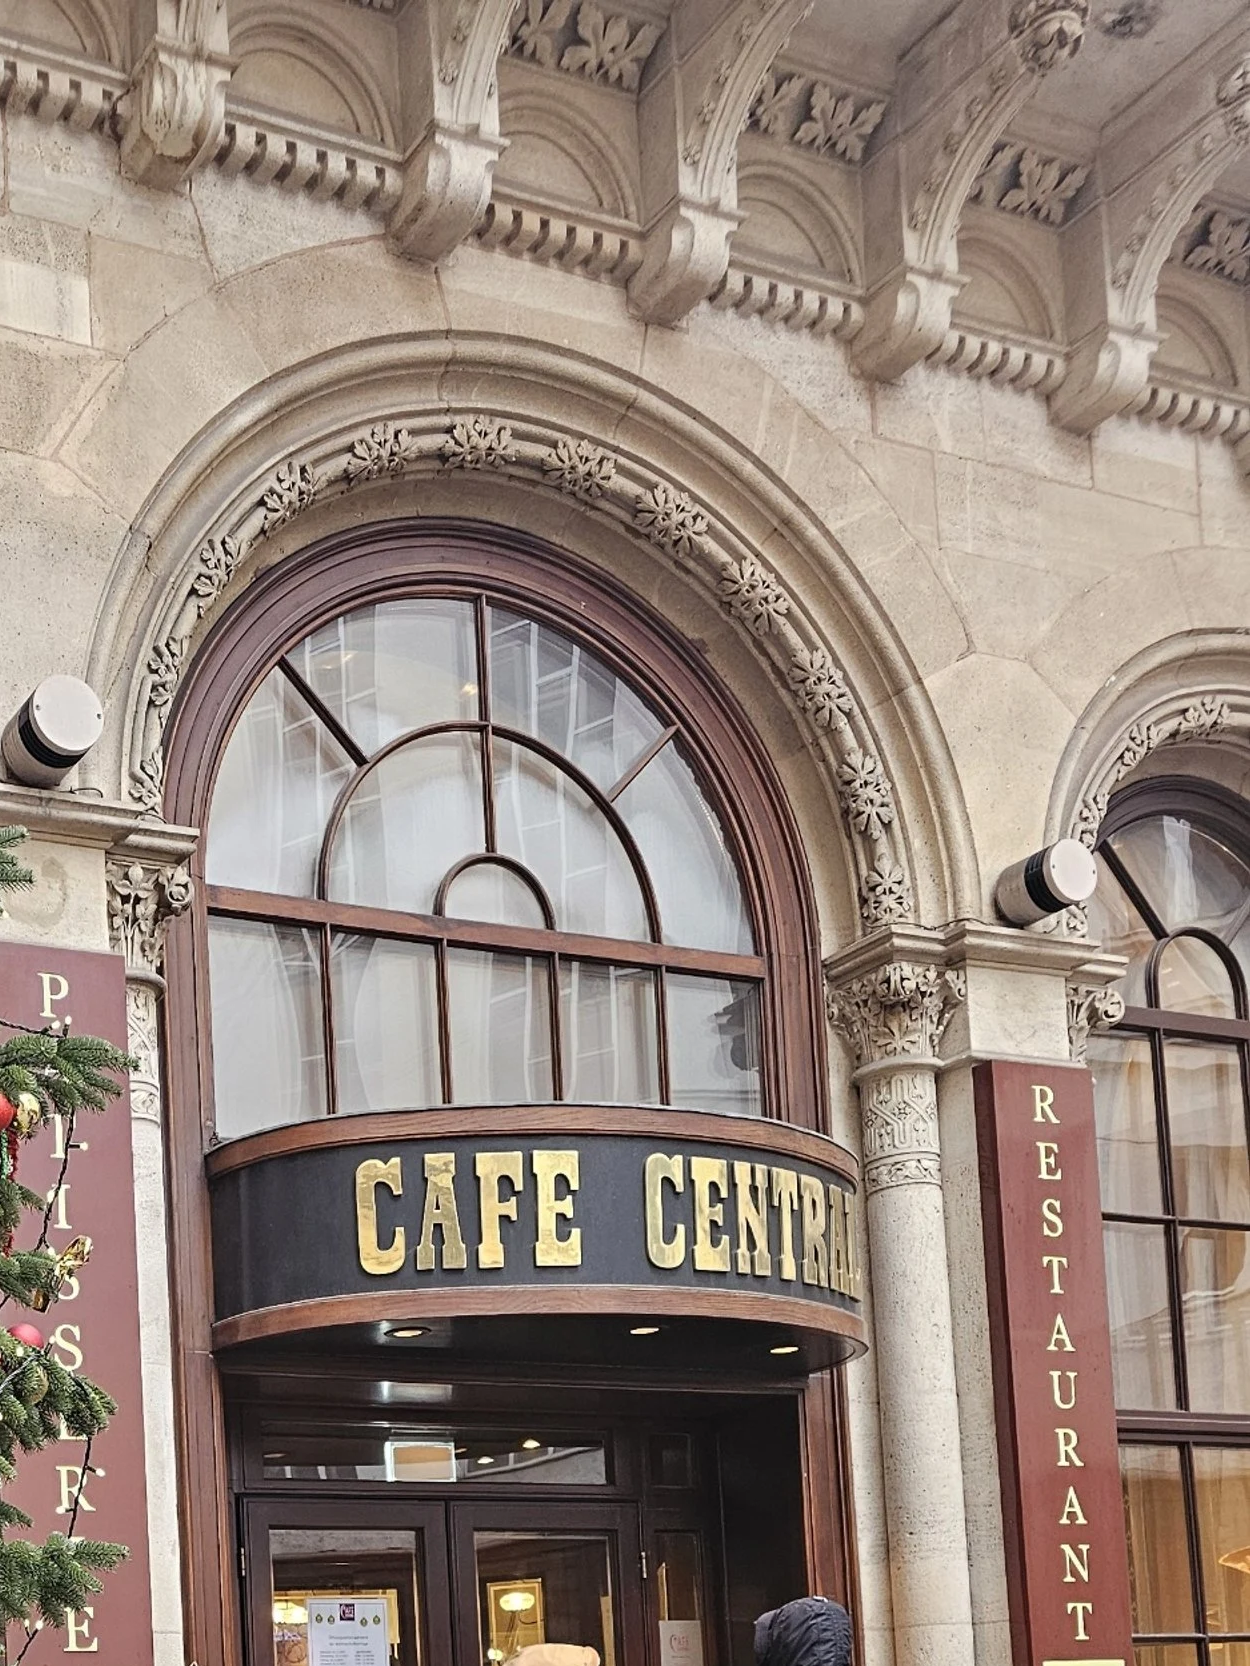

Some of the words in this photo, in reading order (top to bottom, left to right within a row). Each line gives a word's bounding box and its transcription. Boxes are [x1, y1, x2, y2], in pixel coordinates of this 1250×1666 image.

[355, 1149, 583, 1276] CAFE
[645, 1152, 862, 1303] CENTRAL
[1031, 1084, 1094, 1642] RESTAURANT
